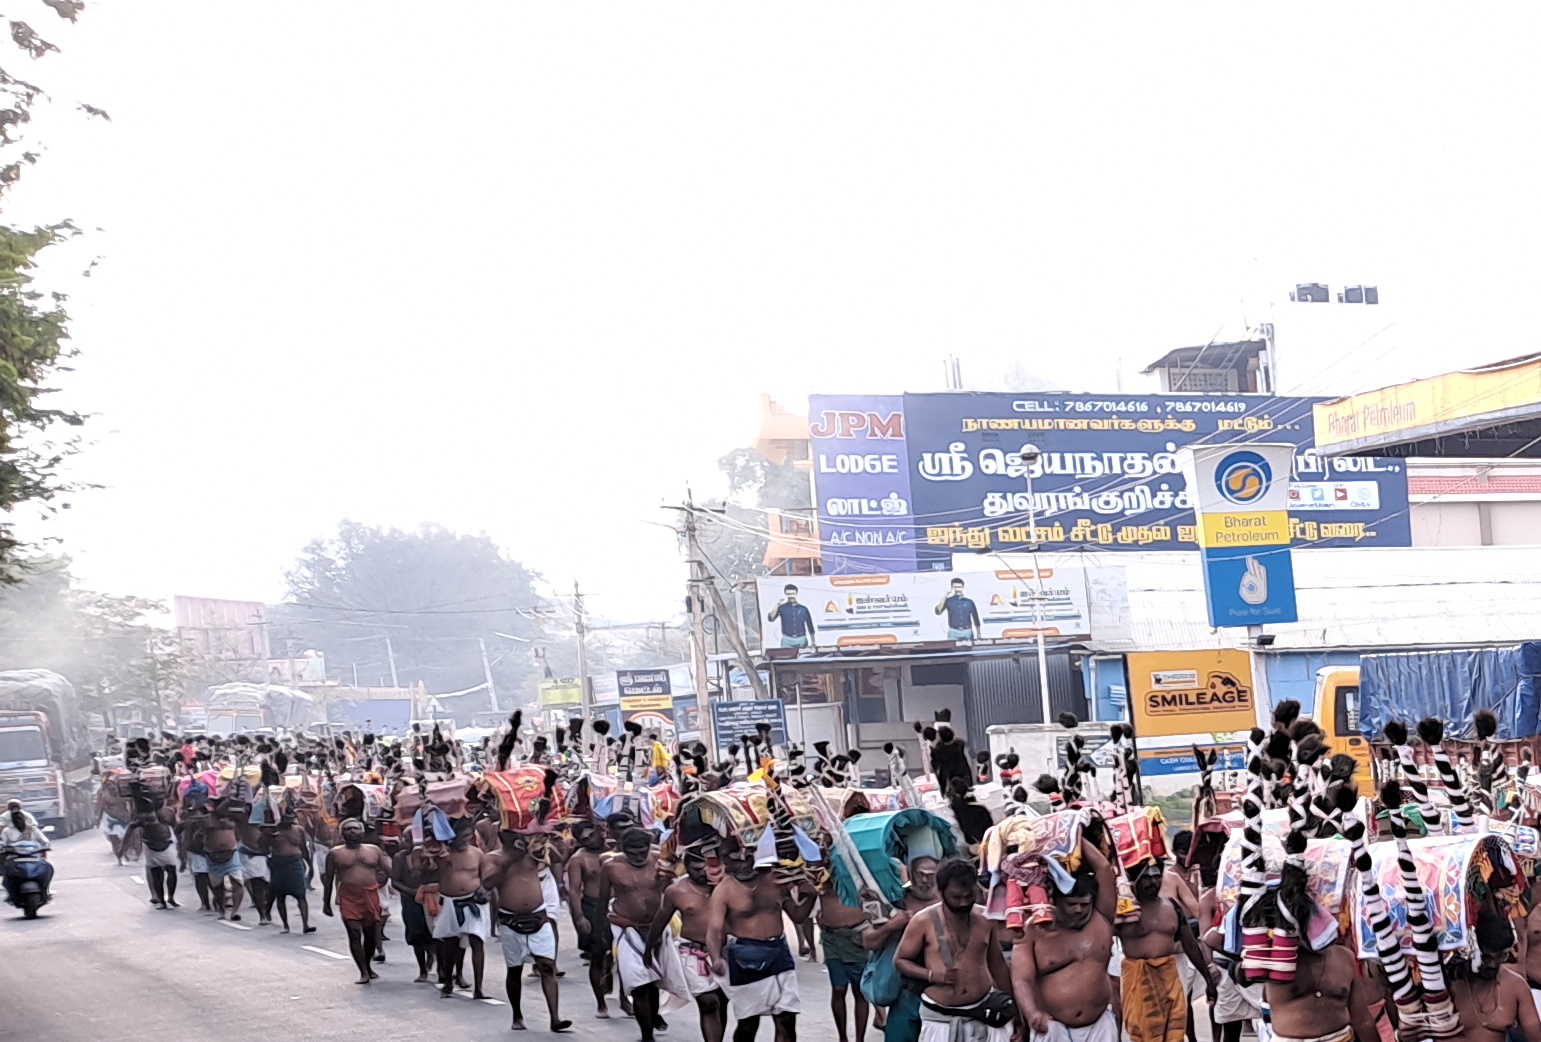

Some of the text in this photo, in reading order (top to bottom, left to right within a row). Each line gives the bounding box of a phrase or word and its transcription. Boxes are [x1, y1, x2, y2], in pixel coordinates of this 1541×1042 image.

[1064, 401, 1149, 412] 7867014616
[1165, 401, 1247, 412] 7867014619
[810, 411, 905, 440] JPM
[819, 454, 899, 474] LODGE
[1224, 516, 1267, 527] Bharat
[855, 530, 883, 545] NON
[885, 530, 908, 545] A/C
[1215, 530, 1279, 543] Petroleum
[1148, 689, 1249, 708] SMILEAGE
